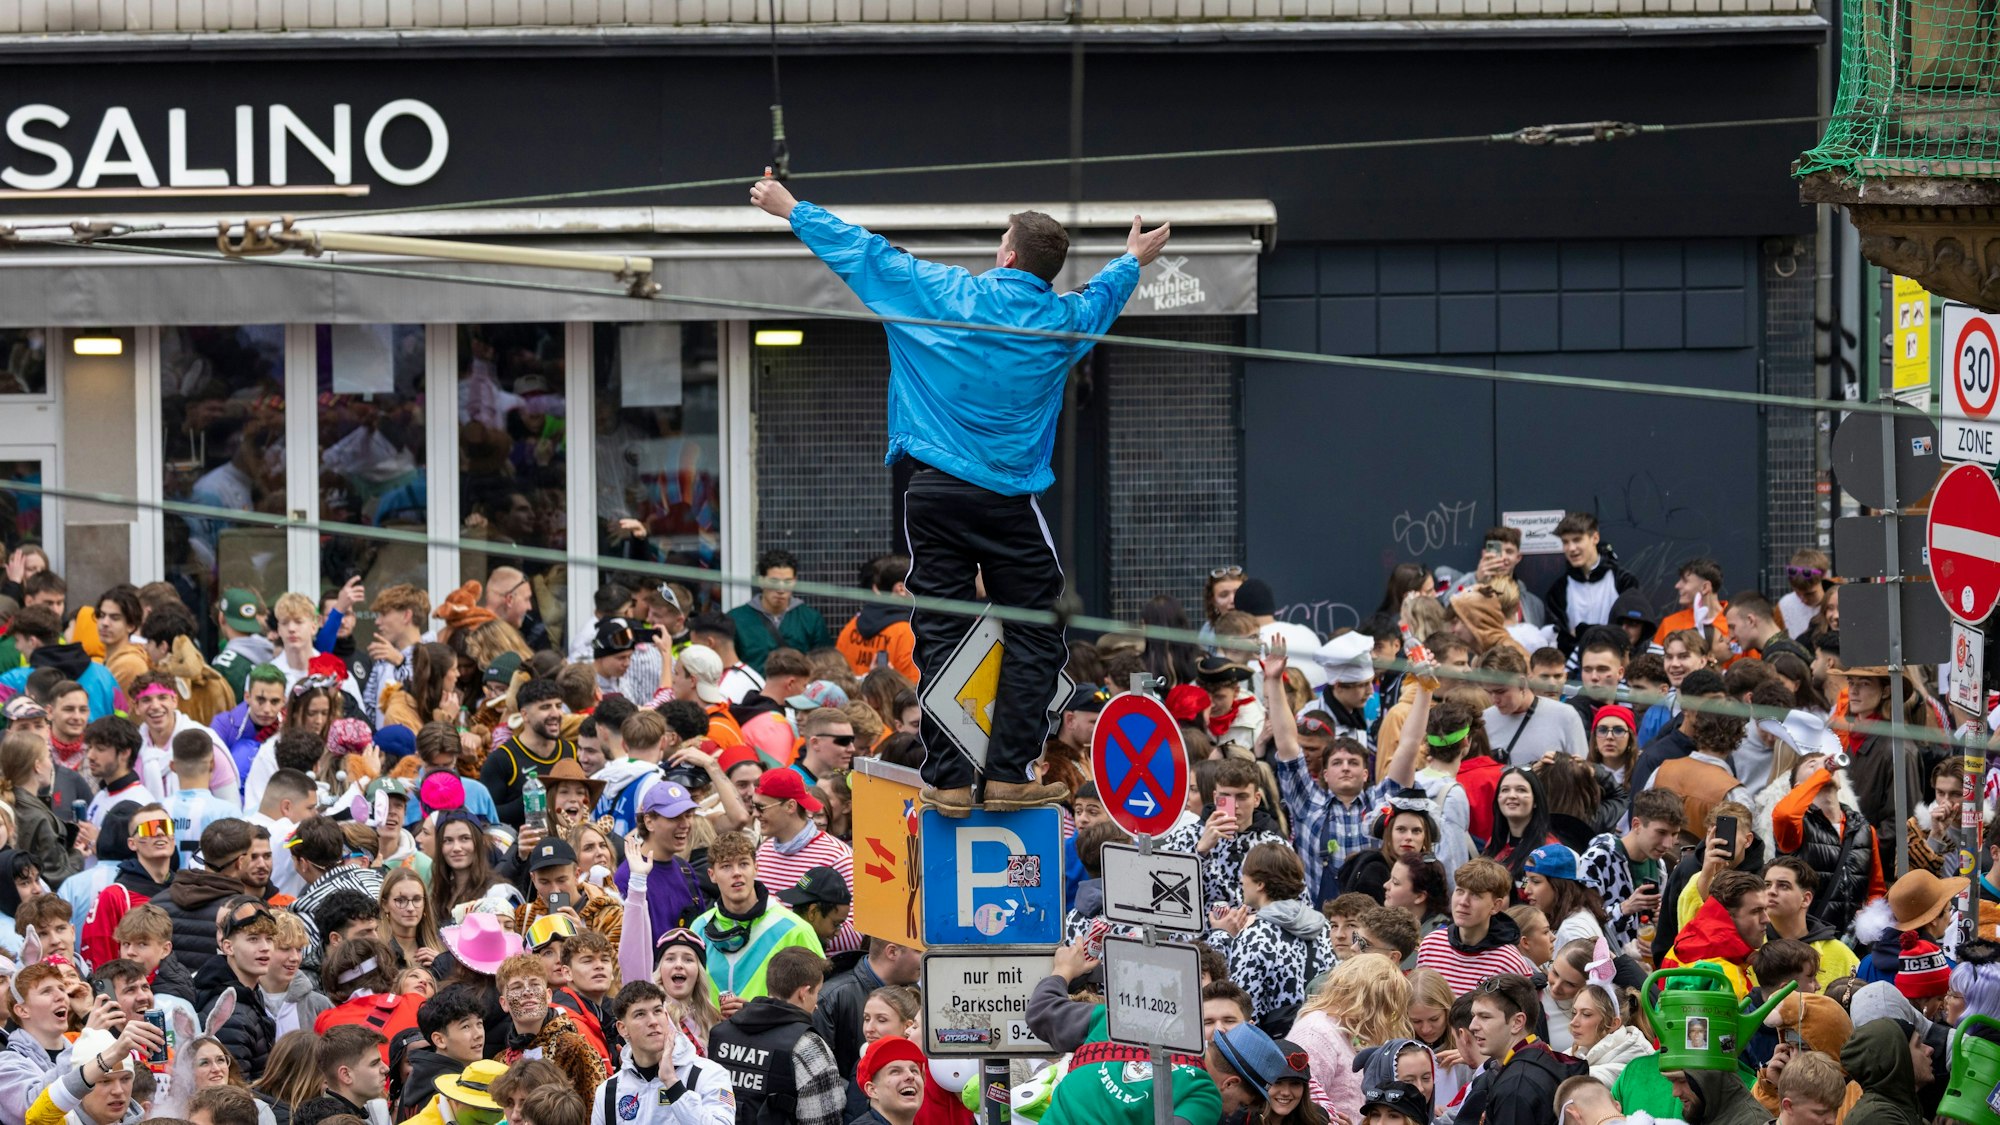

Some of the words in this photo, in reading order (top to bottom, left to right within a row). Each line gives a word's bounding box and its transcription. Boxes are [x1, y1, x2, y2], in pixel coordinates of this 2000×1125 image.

[0, 98, 450, 191] SALINO
[1137, 276, 1200, 301] Mühlen
[1153, 289, 1206, 311] Kölsch
[1963, 345, 1990, 394] 30
[1958, 427, 1993, 456] ZONE
[956, 827, 1027, 927] P
[963, 971, 989, 984] nur
[998, 966, 1022, 984] mit
[1904, 958, 1930, 971] ICE
[952, 995, 1030, 1013] Parkschei
[1118, 992, 1177, 1015] 11.11.2023
[718, 1043, 769, 1066] SWAT
[731, 1070, 763, 1090] LICE
[1097, 1067, 1132, 1104] PEOPLE
